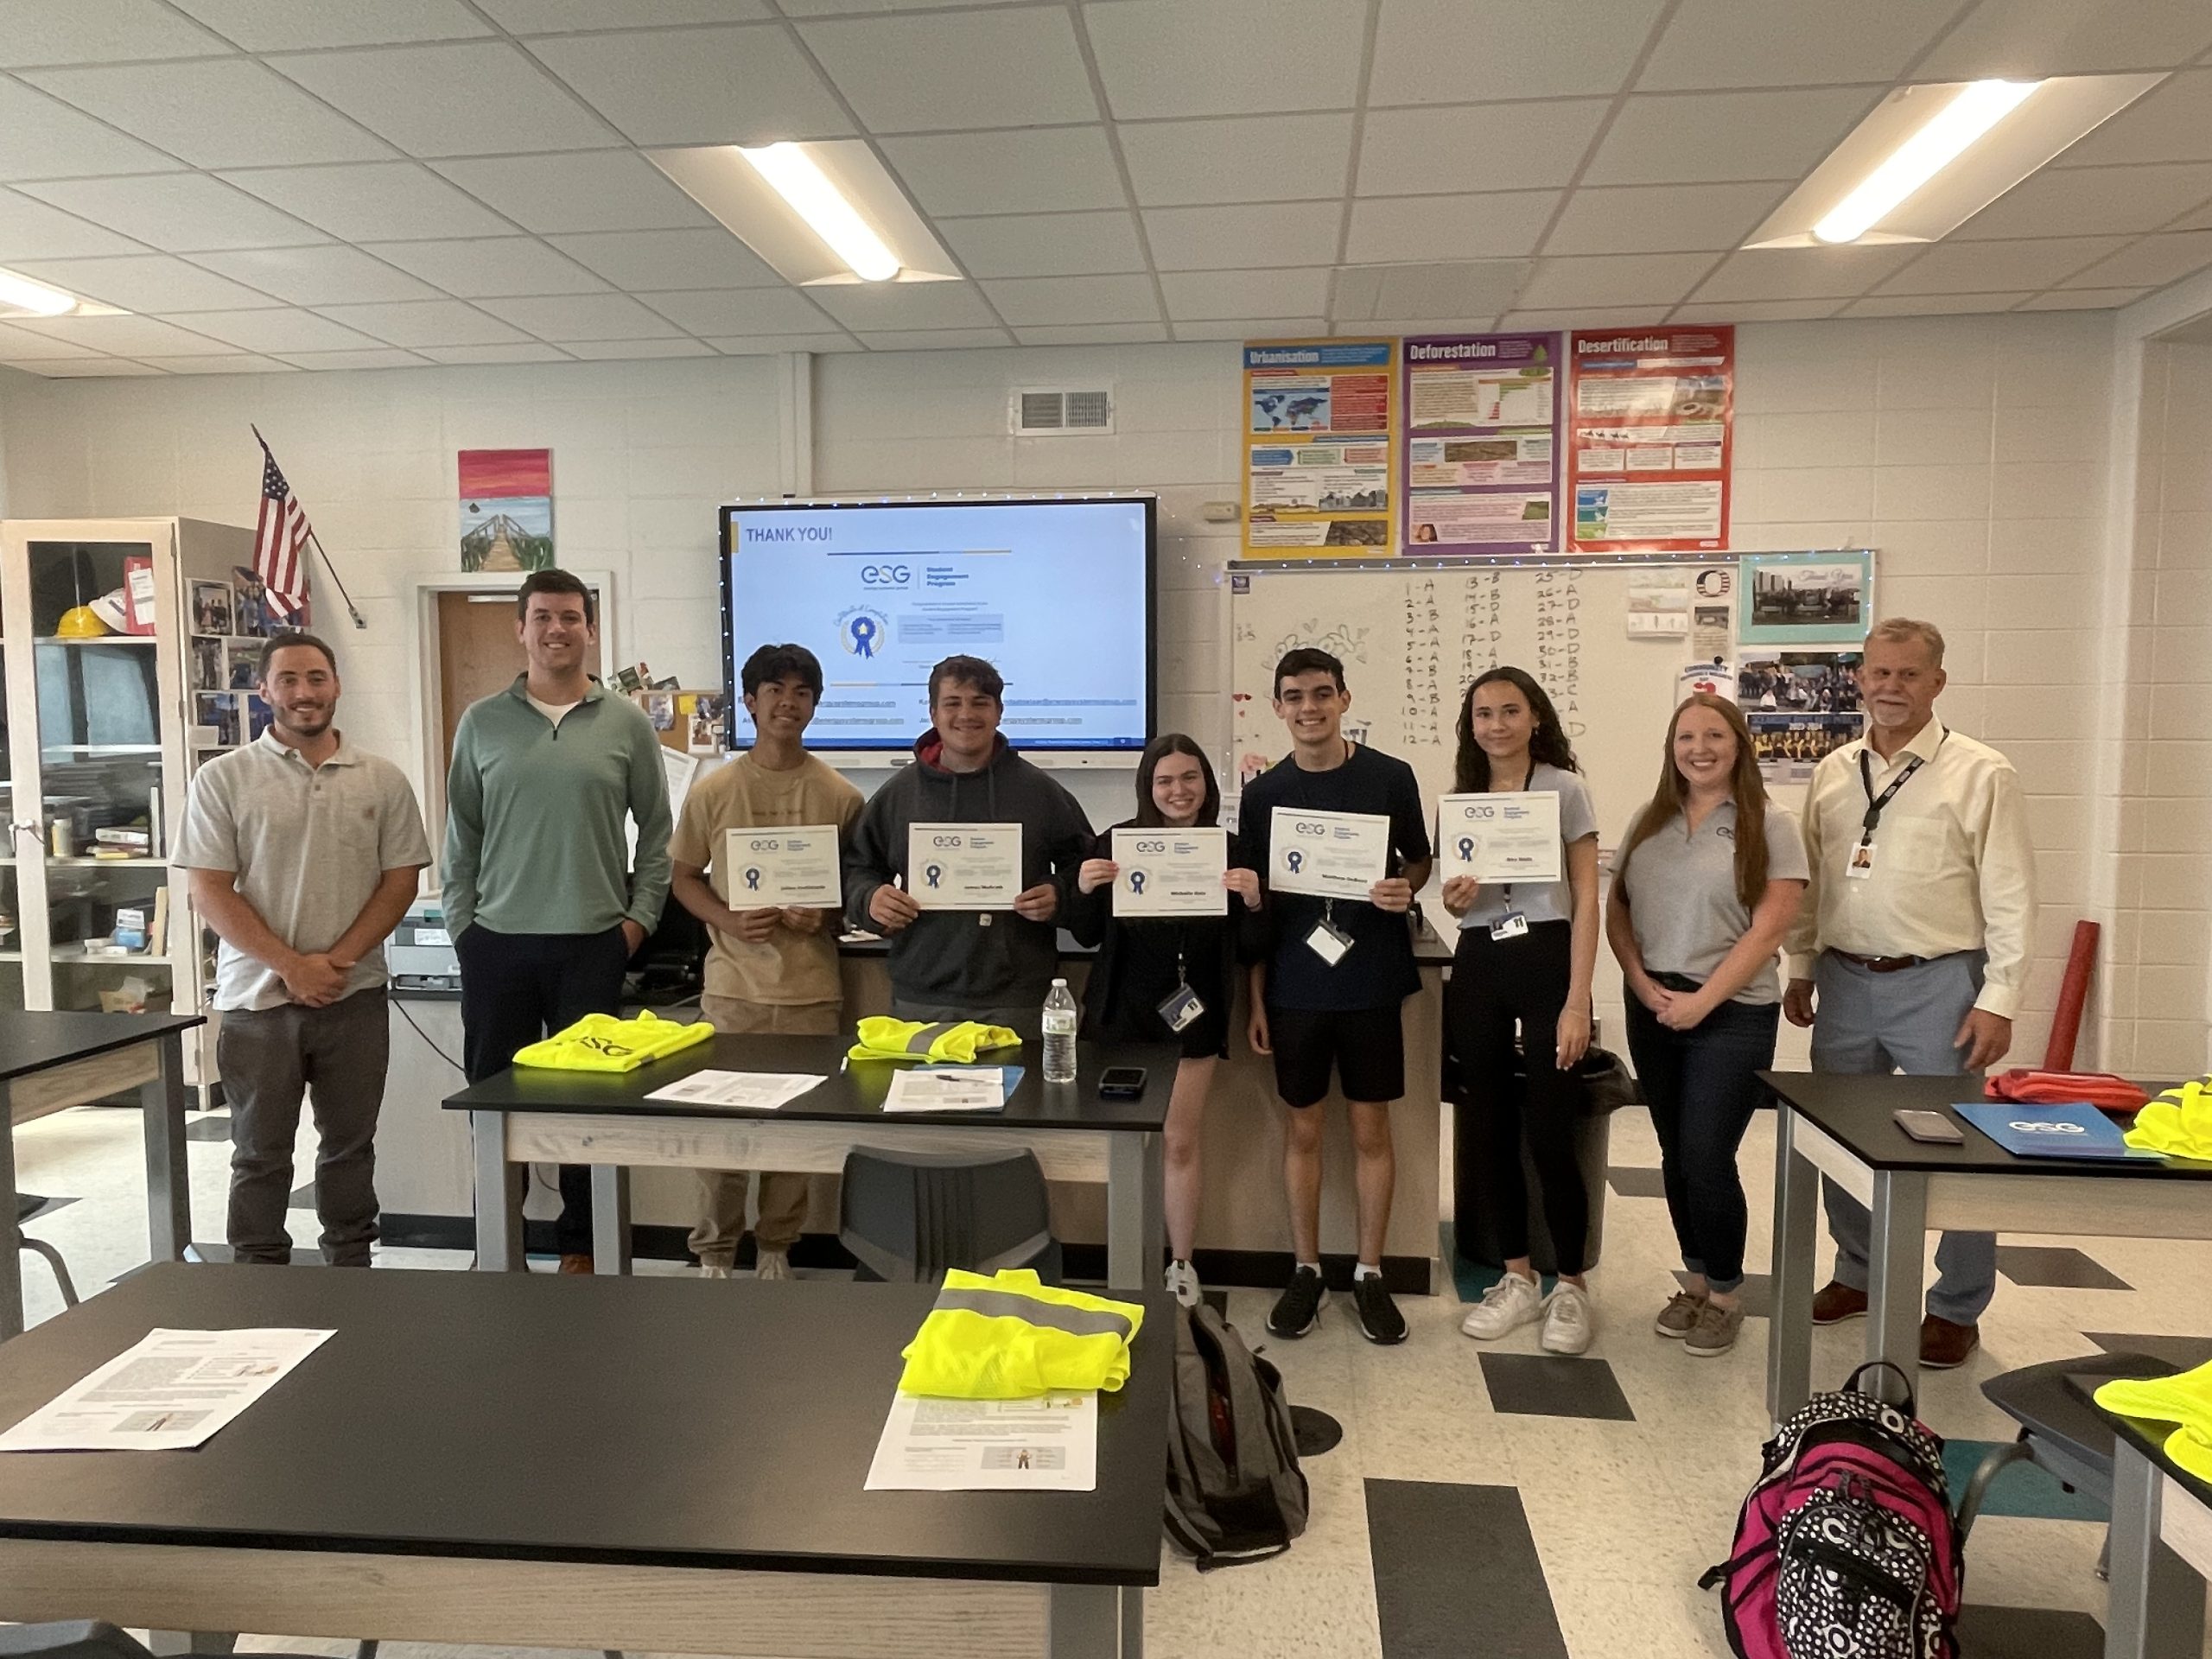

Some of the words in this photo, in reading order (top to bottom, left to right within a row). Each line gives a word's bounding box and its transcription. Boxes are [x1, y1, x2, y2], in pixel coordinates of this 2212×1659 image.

[1410, 342, 1496, 360] Deforestation
[1578, 335, 1669, 353] Desertification
[1249, 349, 1319, 364] Urbanisation
[746, 527, 796, 543] THANK
[798, 526, 832, 542] YOU!
